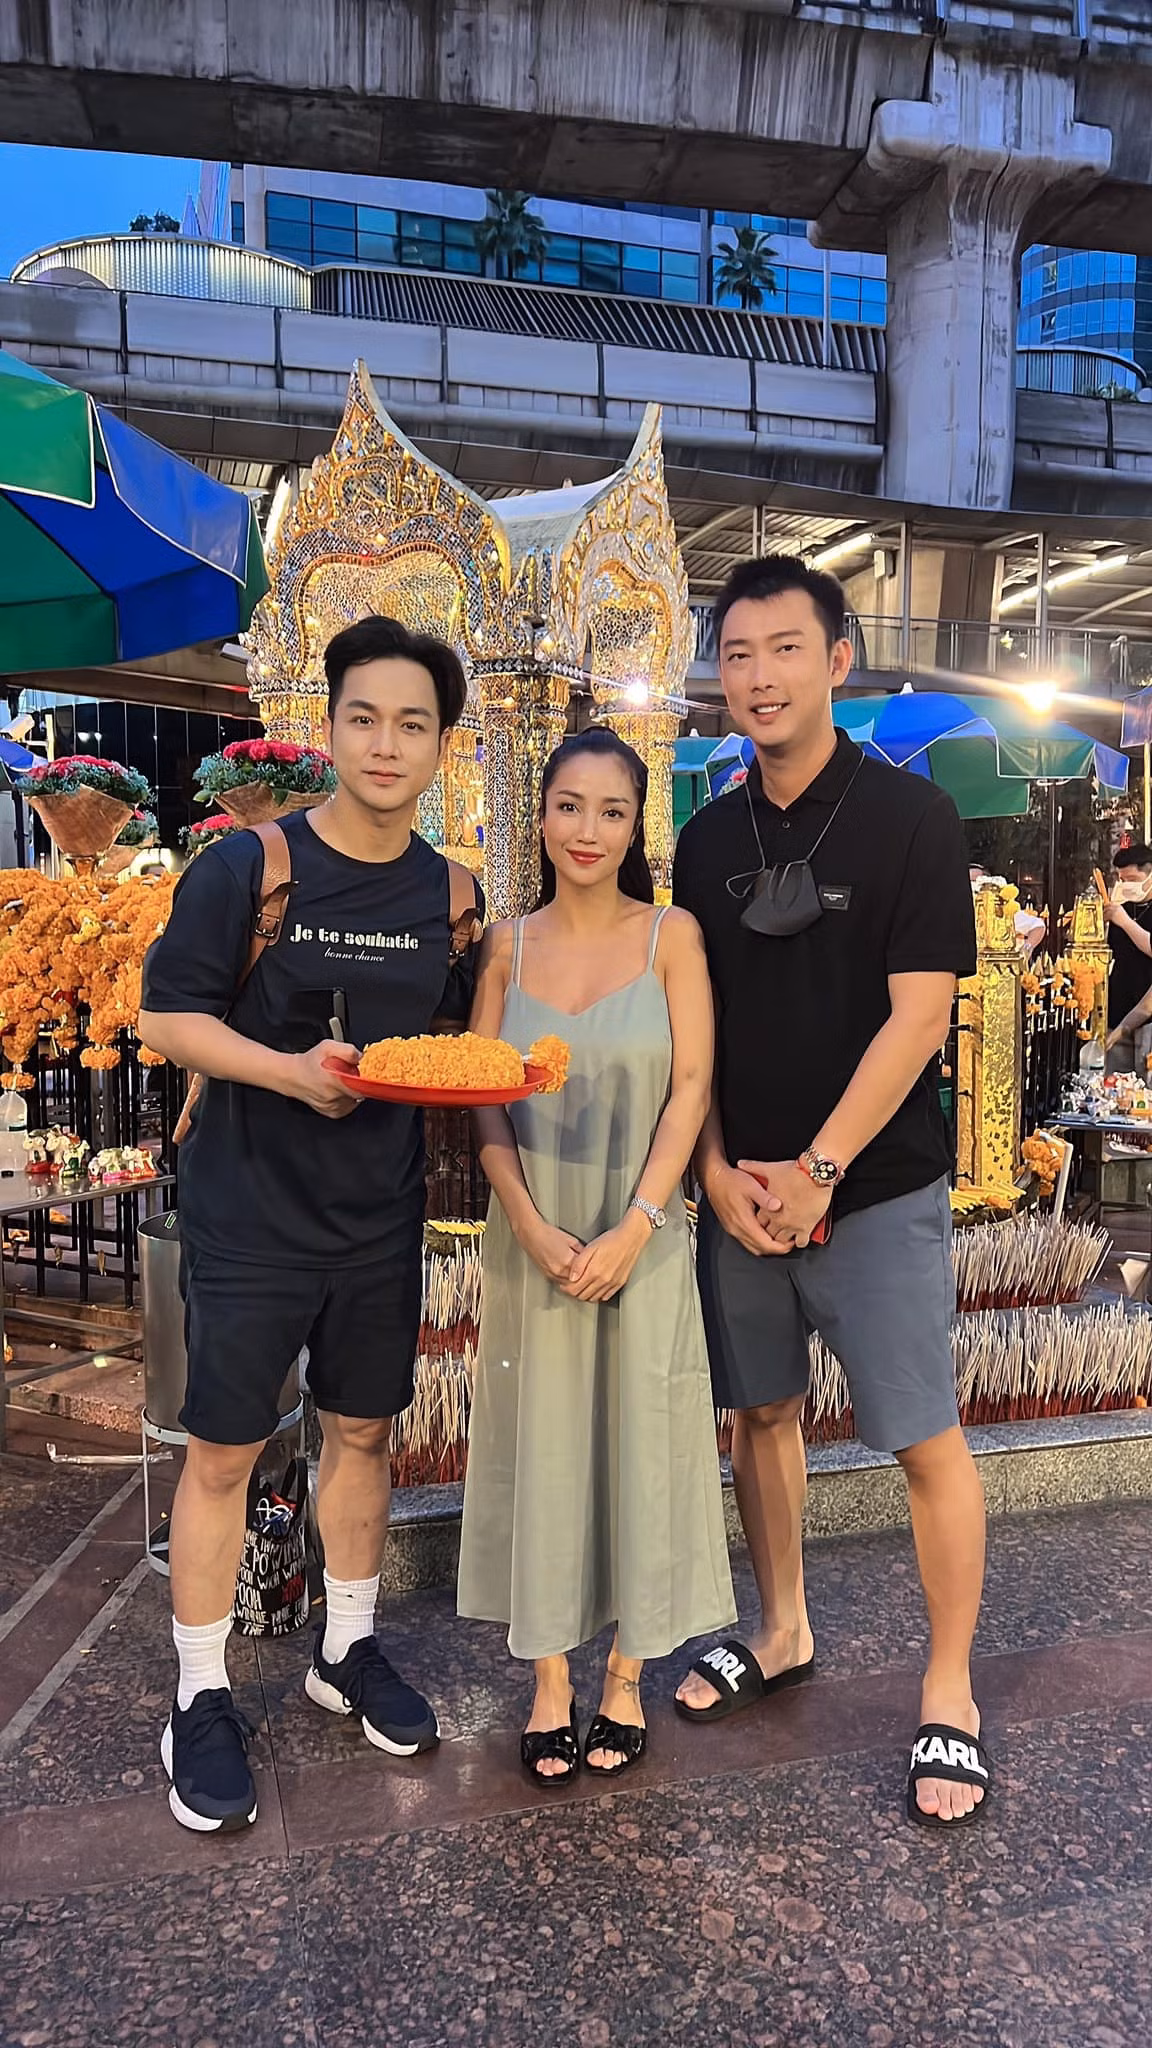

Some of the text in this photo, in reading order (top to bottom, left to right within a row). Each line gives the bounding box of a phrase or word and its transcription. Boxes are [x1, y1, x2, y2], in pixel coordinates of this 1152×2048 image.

[289, 923, 419, 950] Je te souhatie
[324, 947, 385, 962] bonne chance
[910, 1736, 989, 1780] KARL
